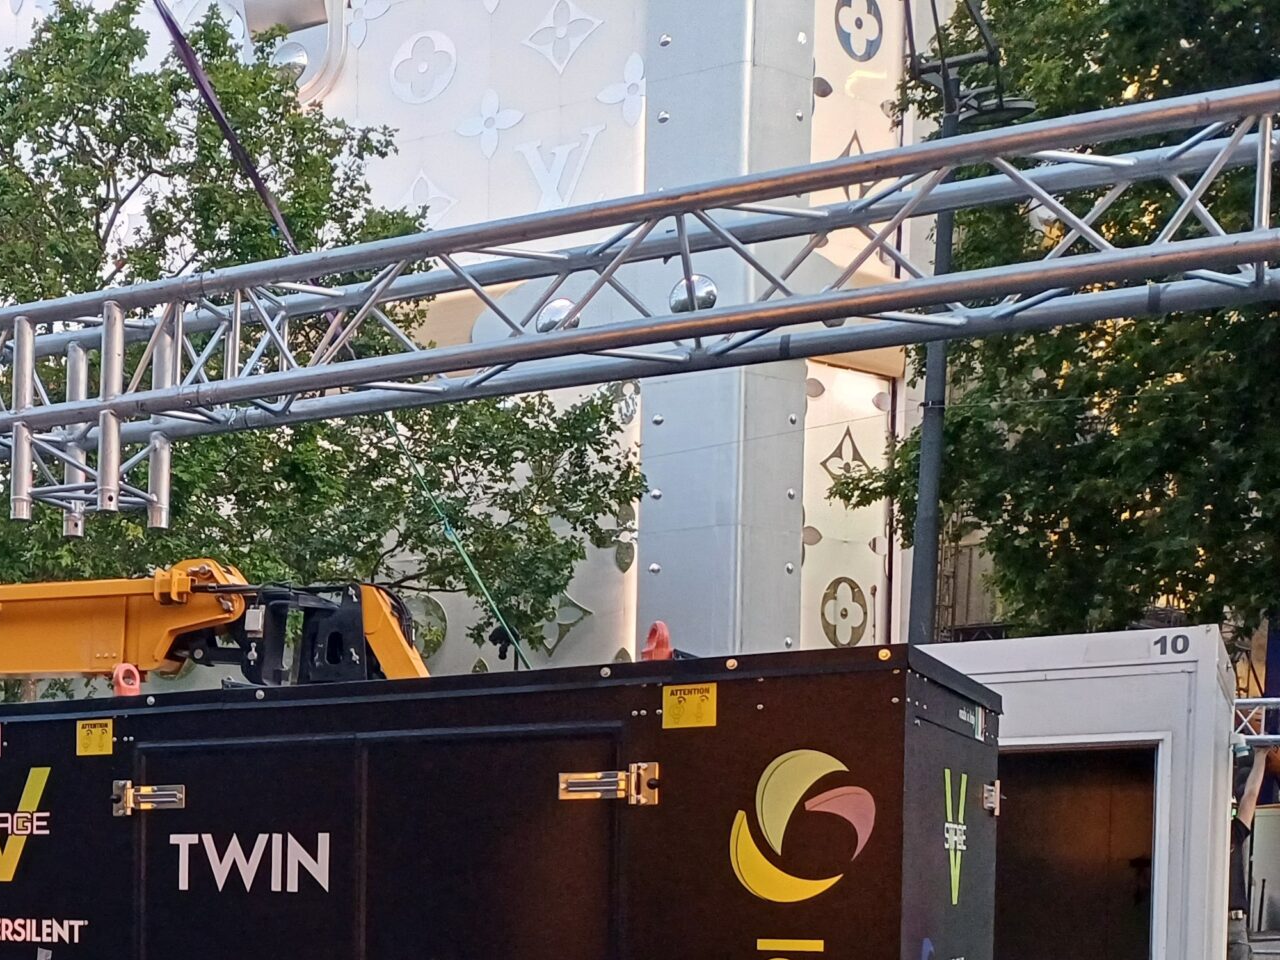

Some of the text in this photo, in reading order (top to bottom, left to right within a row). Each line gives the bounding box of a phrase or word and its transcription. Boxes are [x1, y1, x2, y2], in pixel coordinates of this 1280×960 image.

[1153, 634, 1190, 655] 10
[670, 687, 710, 696] ATTENTION
[169, 832, 331, 893] TWIN
